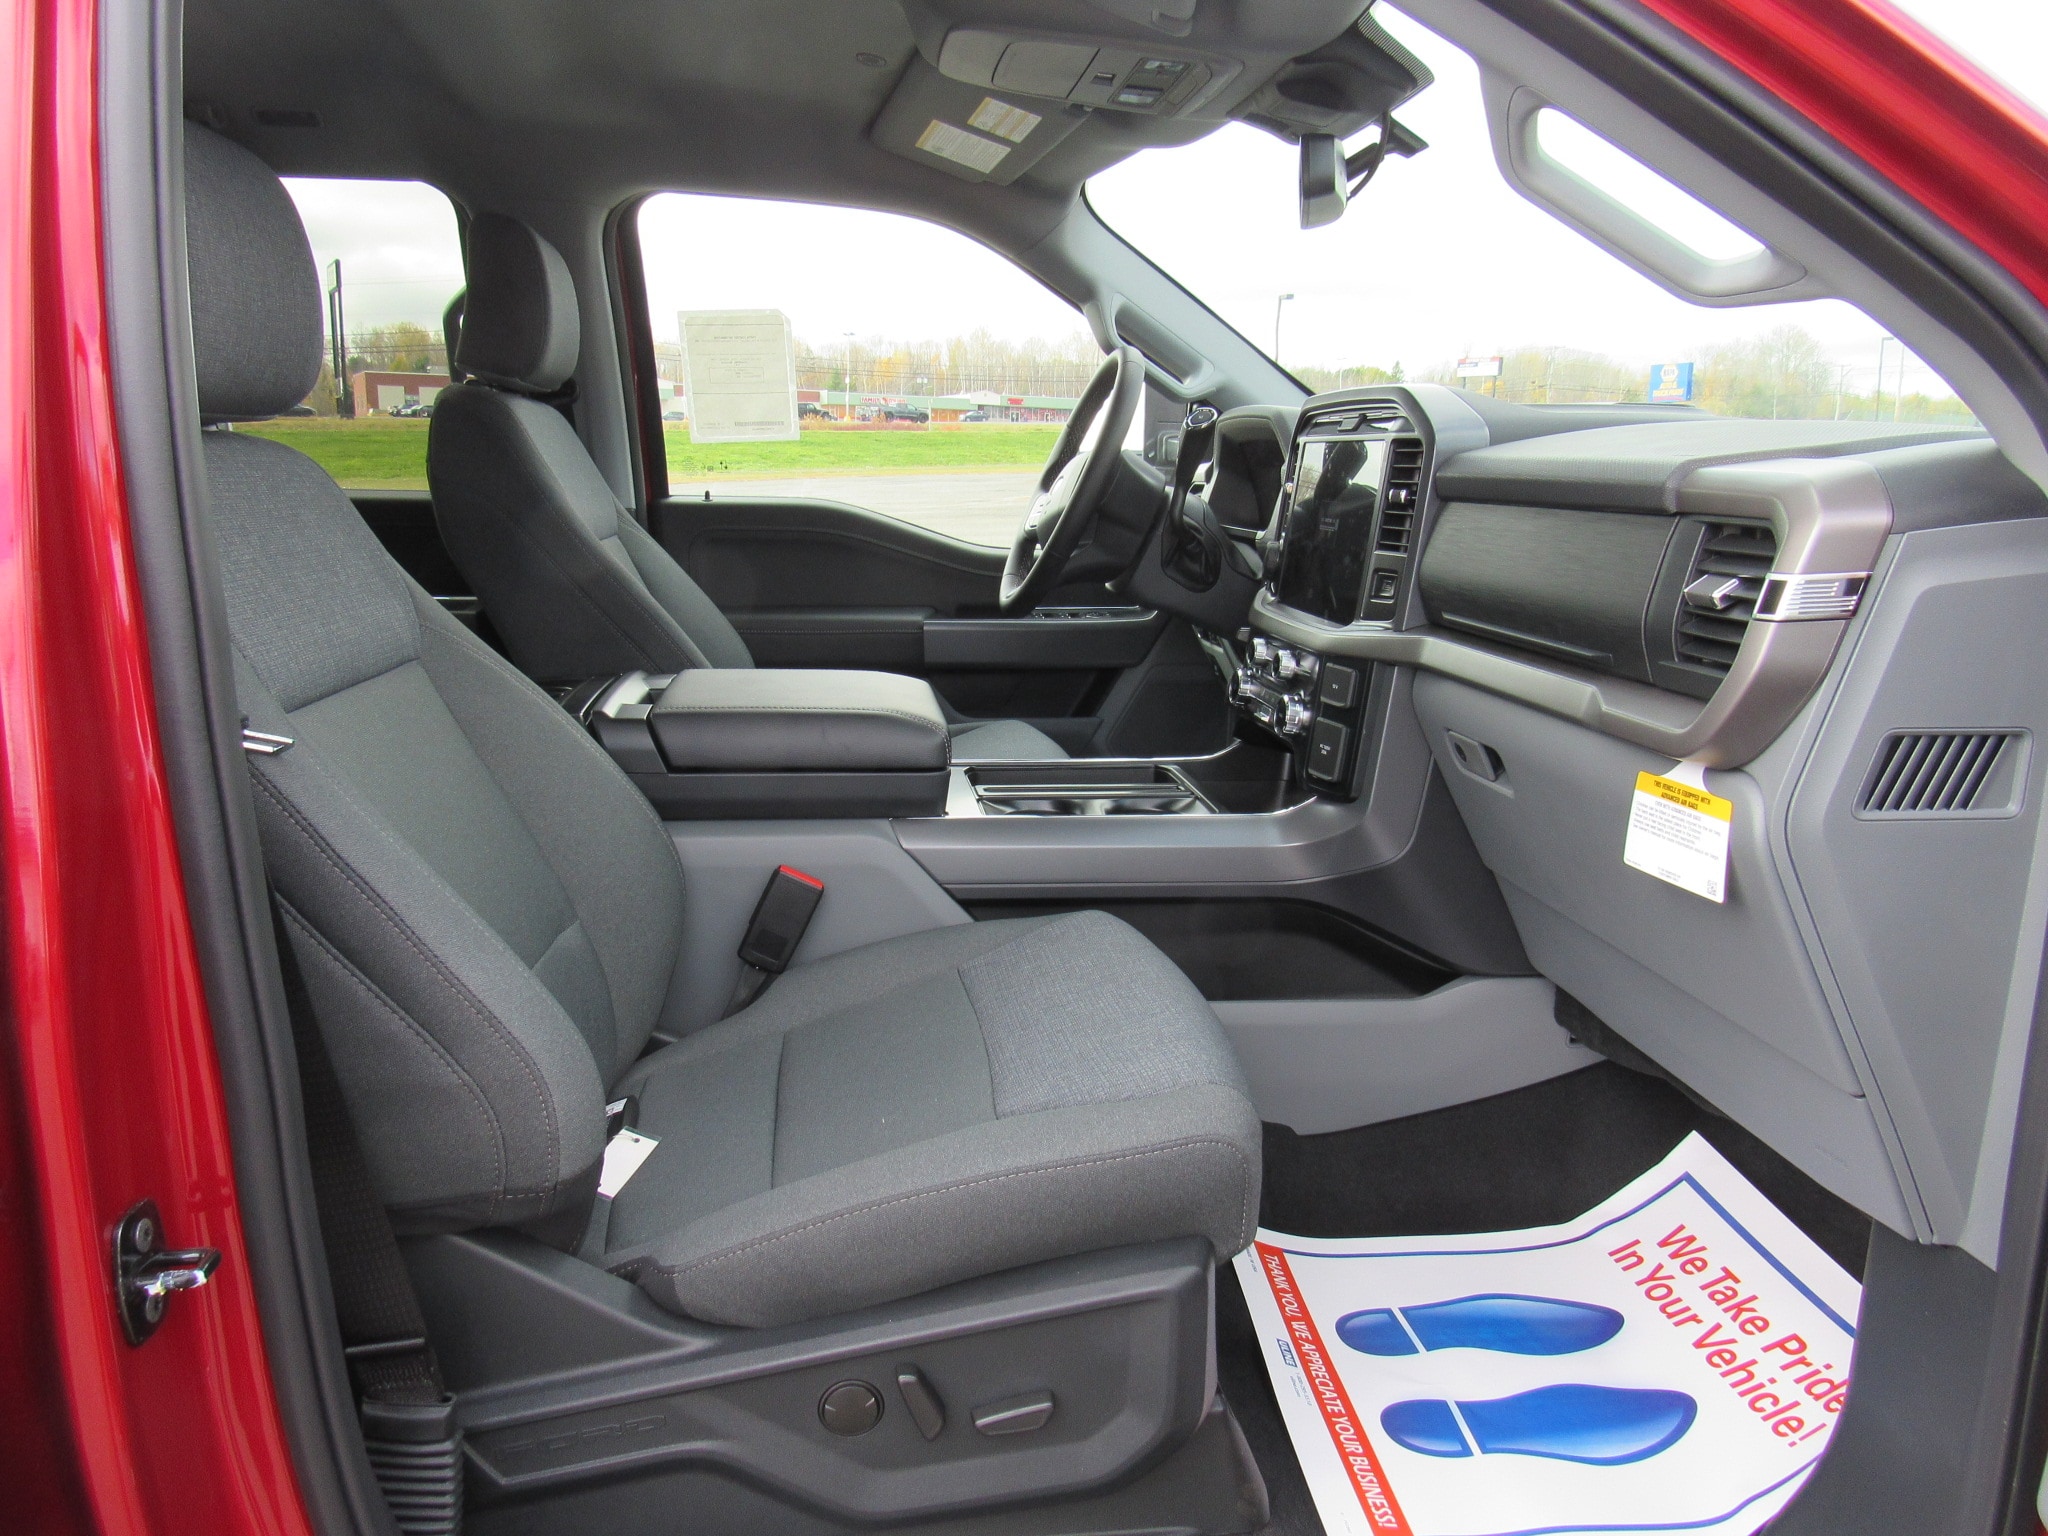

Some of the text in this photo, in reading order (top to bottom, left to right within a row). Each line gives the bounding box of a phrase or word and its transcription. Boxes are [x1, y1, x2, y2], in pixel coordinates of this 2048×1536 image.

[1653, 780, 1662, 788] THIS
[1662, 783, 1677, 794] VEHICLE
[1681, 789, 1700, 801] EQUIPPED
[1700, 796, 1711, 805] WITH
[1661, 791, 1681, 804] ADVANCED
[1680, 798, 1688, 806] AIR
[1278, 1340, 1297, 1367] ULINE
[1607, 1238, 1827, 1448] In Your Vehicle!
[1656, 1223, 1850, 1413] We Take Pride
[1263, 1253, 1399, 1529] THANK YOU, WE APPRECIATE YOUR BUSINESS!
